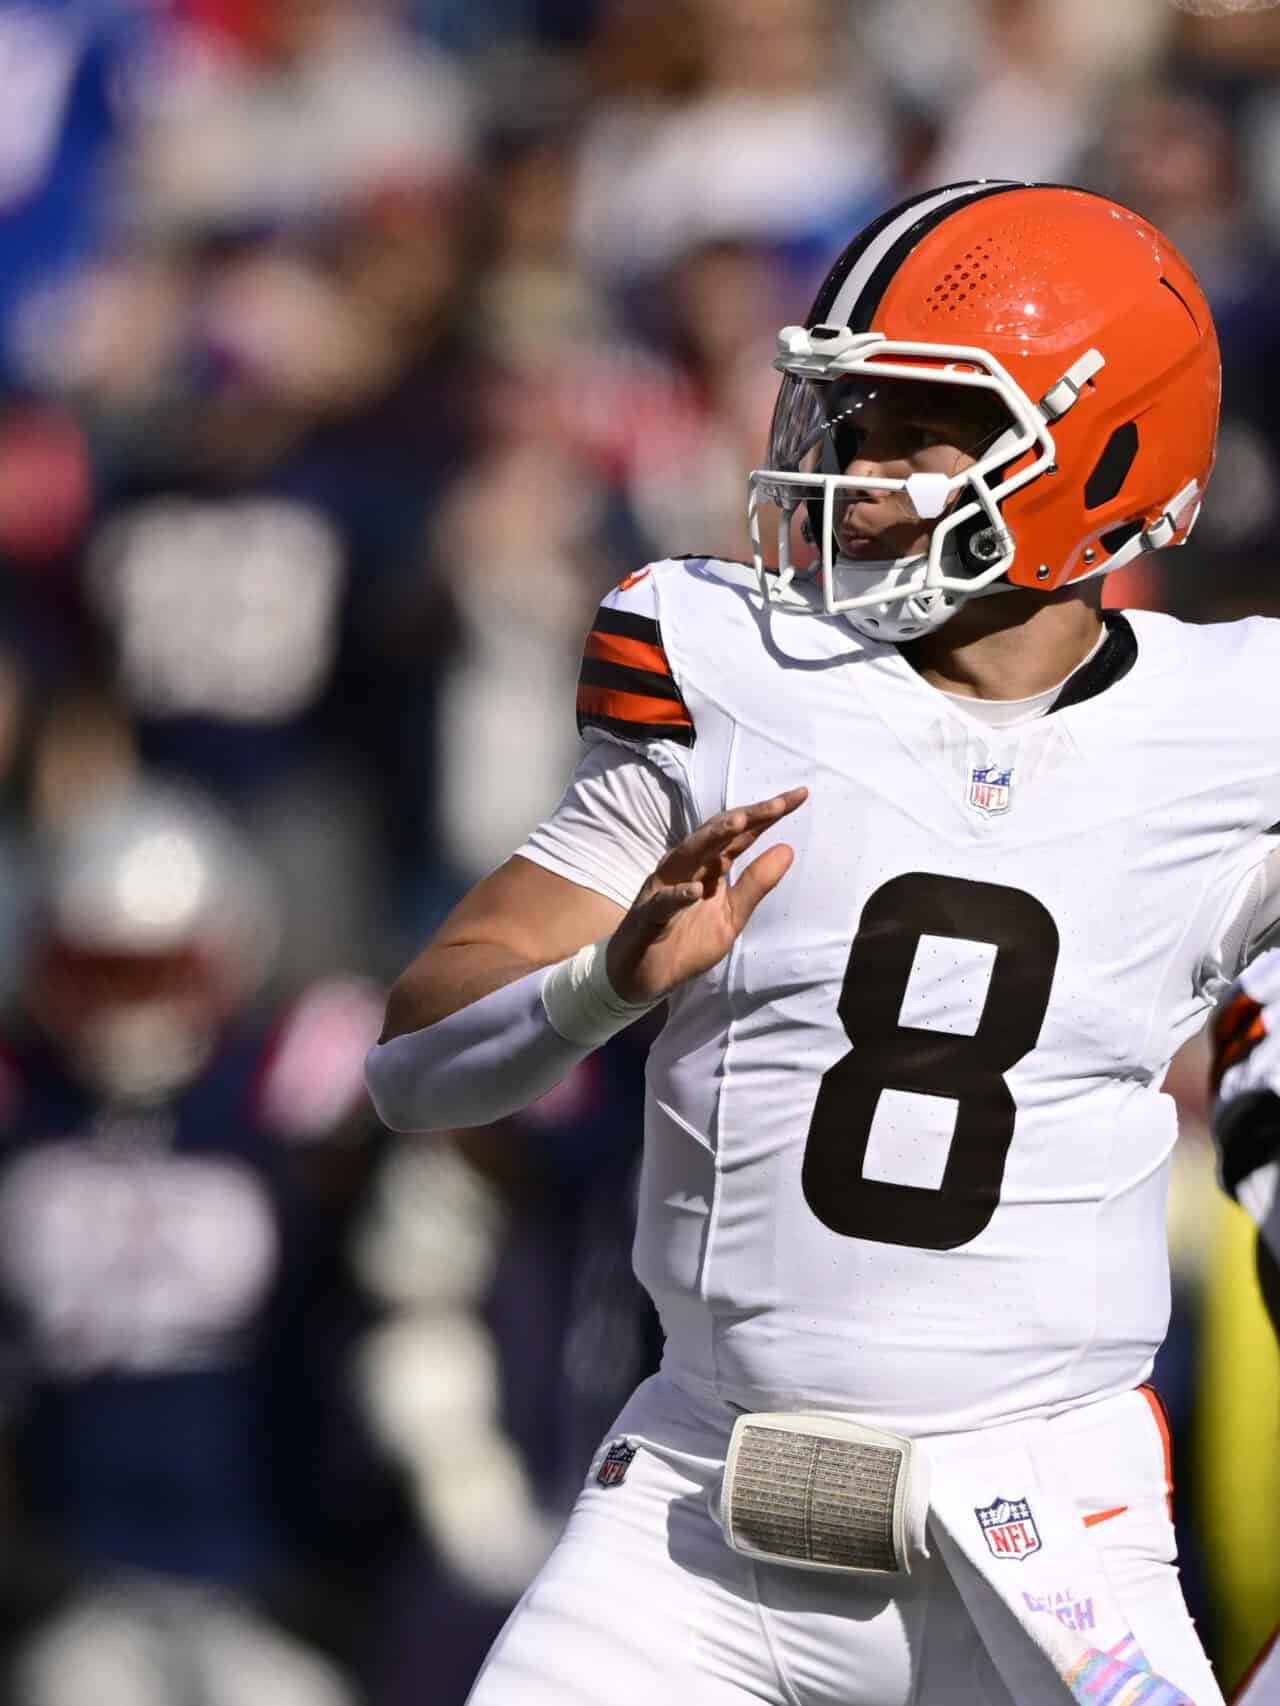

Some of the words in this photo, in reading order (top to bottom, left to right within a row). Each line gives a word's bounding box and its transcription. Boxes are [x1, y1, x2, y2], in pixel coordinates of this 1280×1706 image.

[974, 784, 1006, 808] NFL
[801, 872, 1060, 1251] 8
[989, 1522, 1037, 1553] NFL
